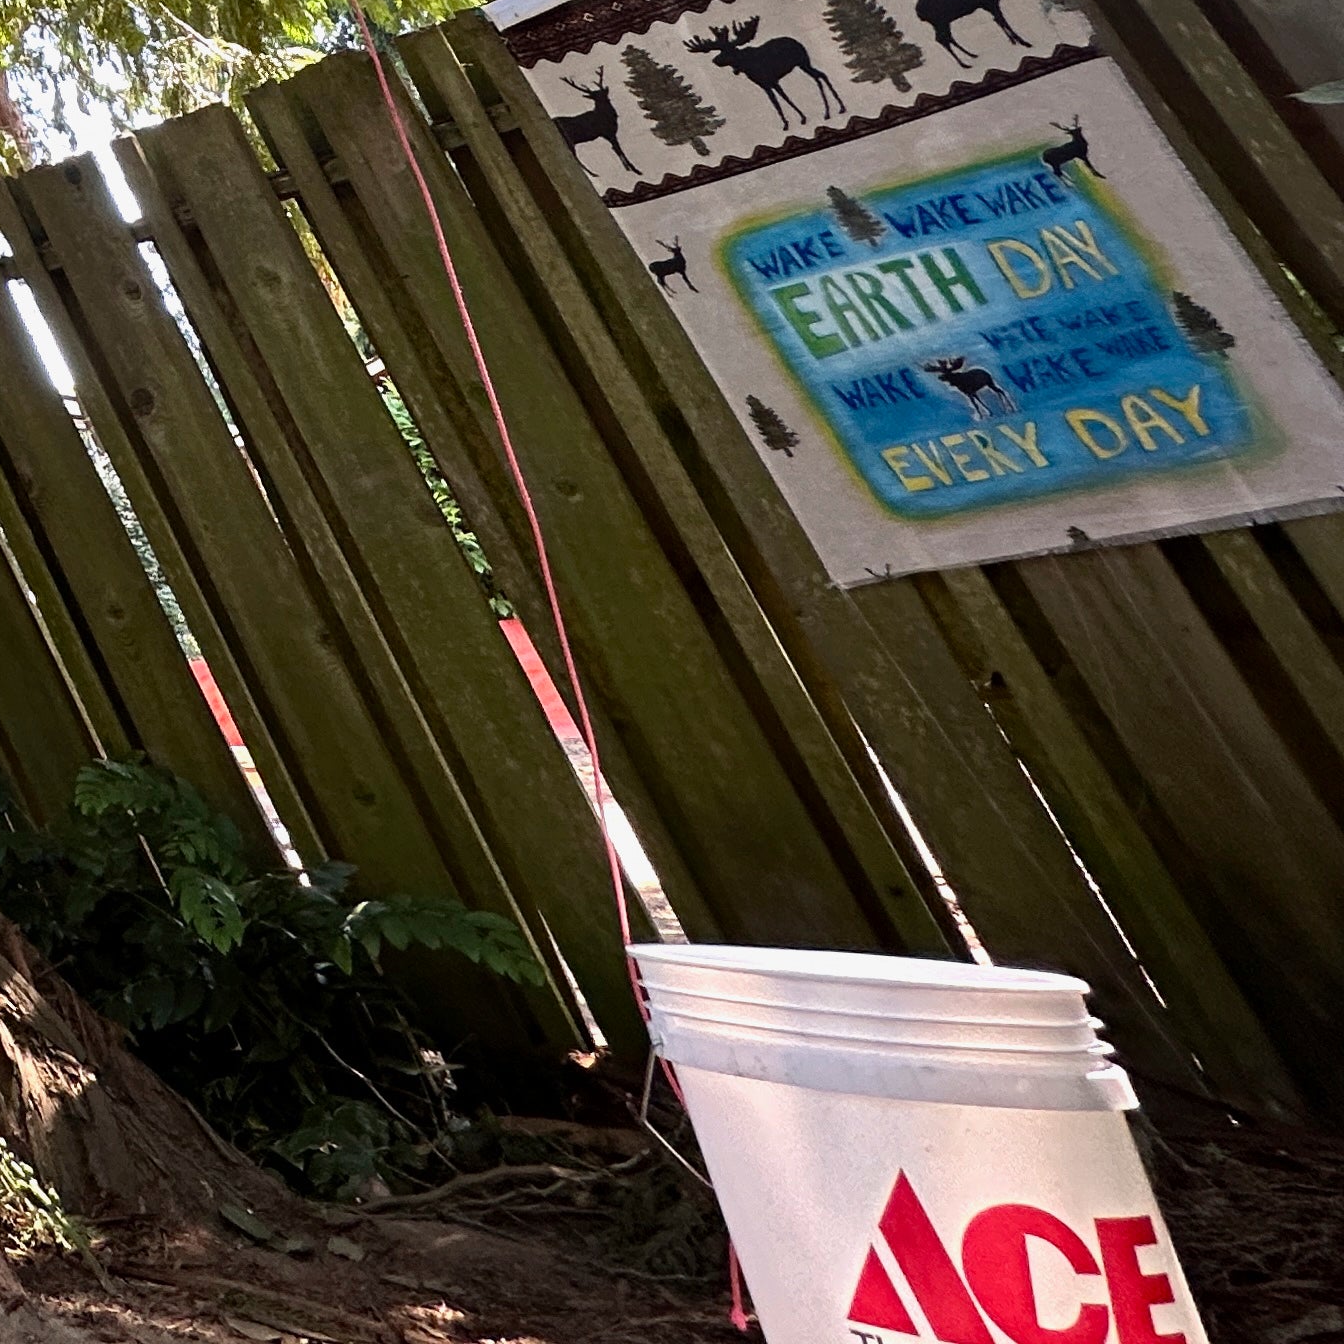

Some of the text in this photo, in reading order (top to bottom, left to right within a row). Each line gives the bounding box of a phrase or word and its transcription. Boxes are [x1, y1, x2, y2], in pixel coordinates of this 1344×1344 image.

[746, 171, 1070, 279] WAKE WAKE WAKE
[770, 219, 1119, 360] EARTH DAY
[831, 325, 1171, 411] WAKE WAKE WAKE
[879, 384, 1210, 492] EVERY DAY
[848, 1168, 1186, 1344] ACE
